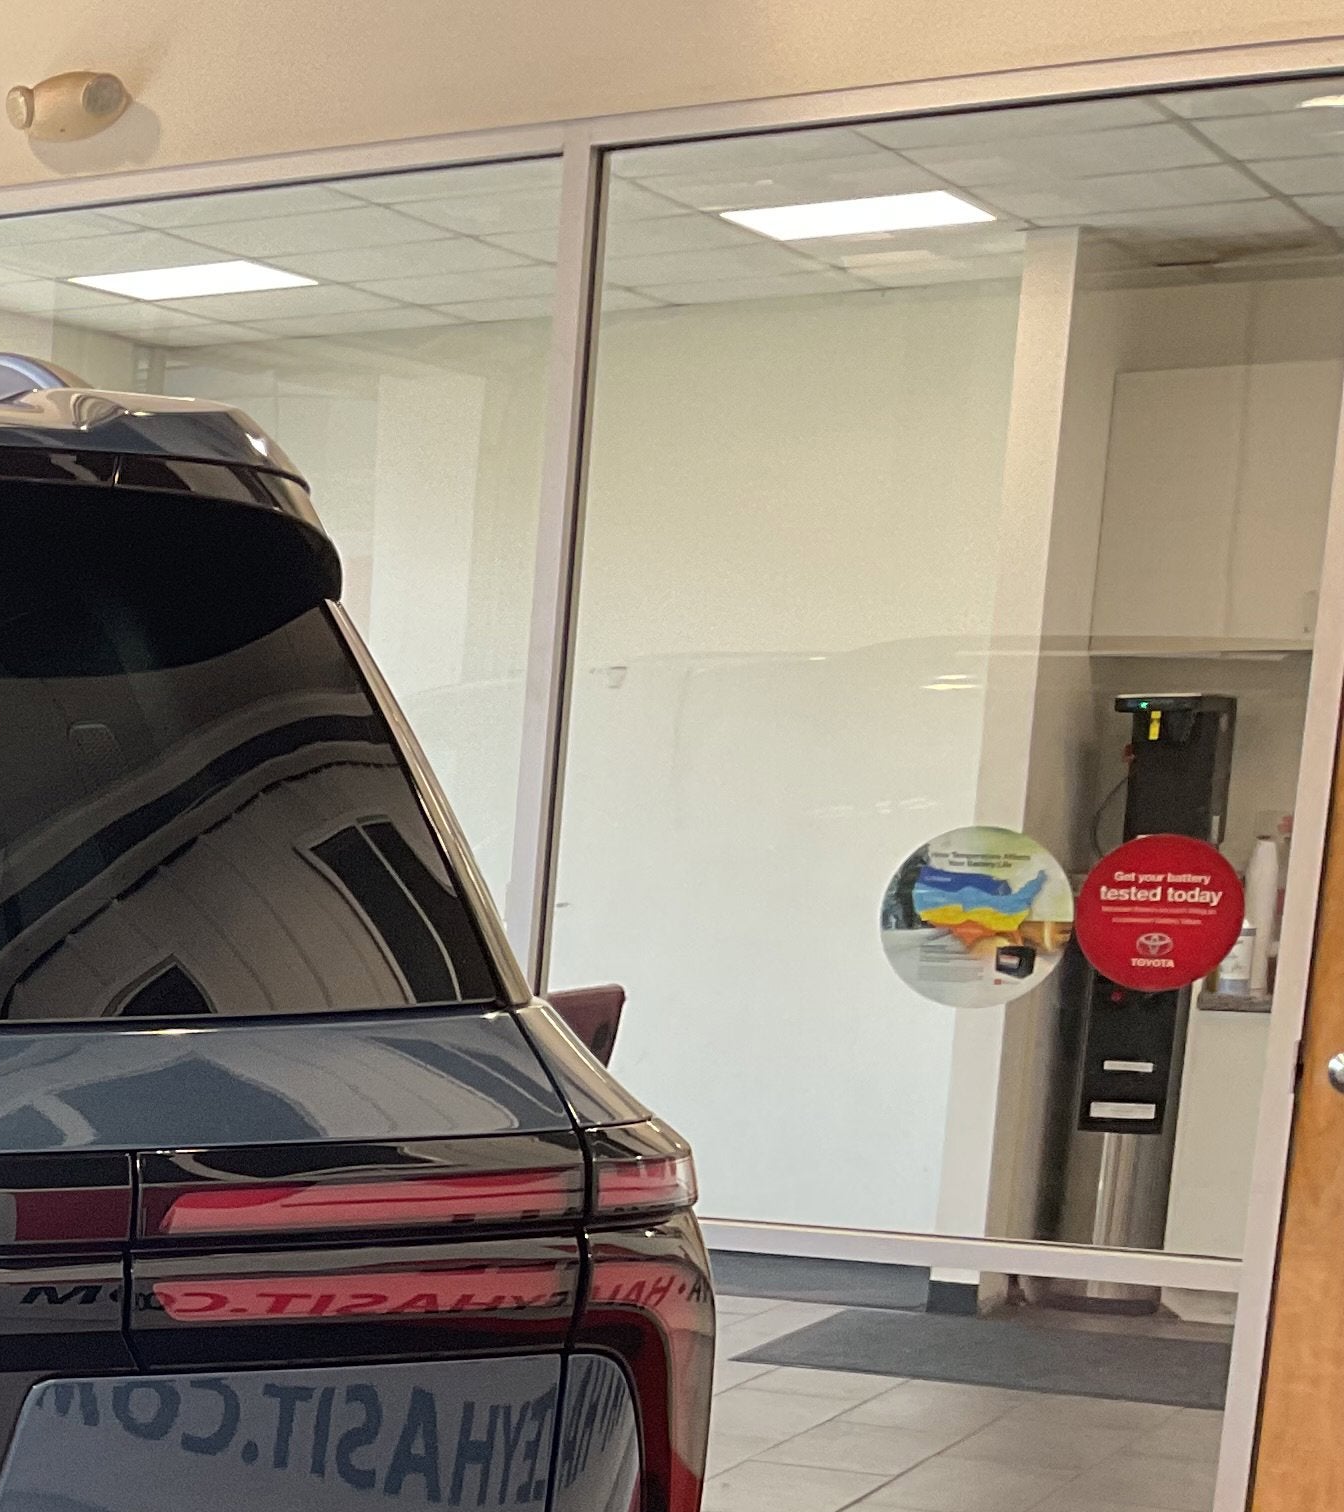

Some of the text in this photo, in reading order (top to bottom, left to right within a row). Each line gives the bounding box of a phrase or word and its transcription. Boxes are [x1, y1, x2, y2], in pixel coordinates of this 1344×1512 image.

[1114, 871, 1211, 885] Get your battery
[1100, 885, 1223, 906] tested today
[1131, 957, 1175, 968] TOYOTA
